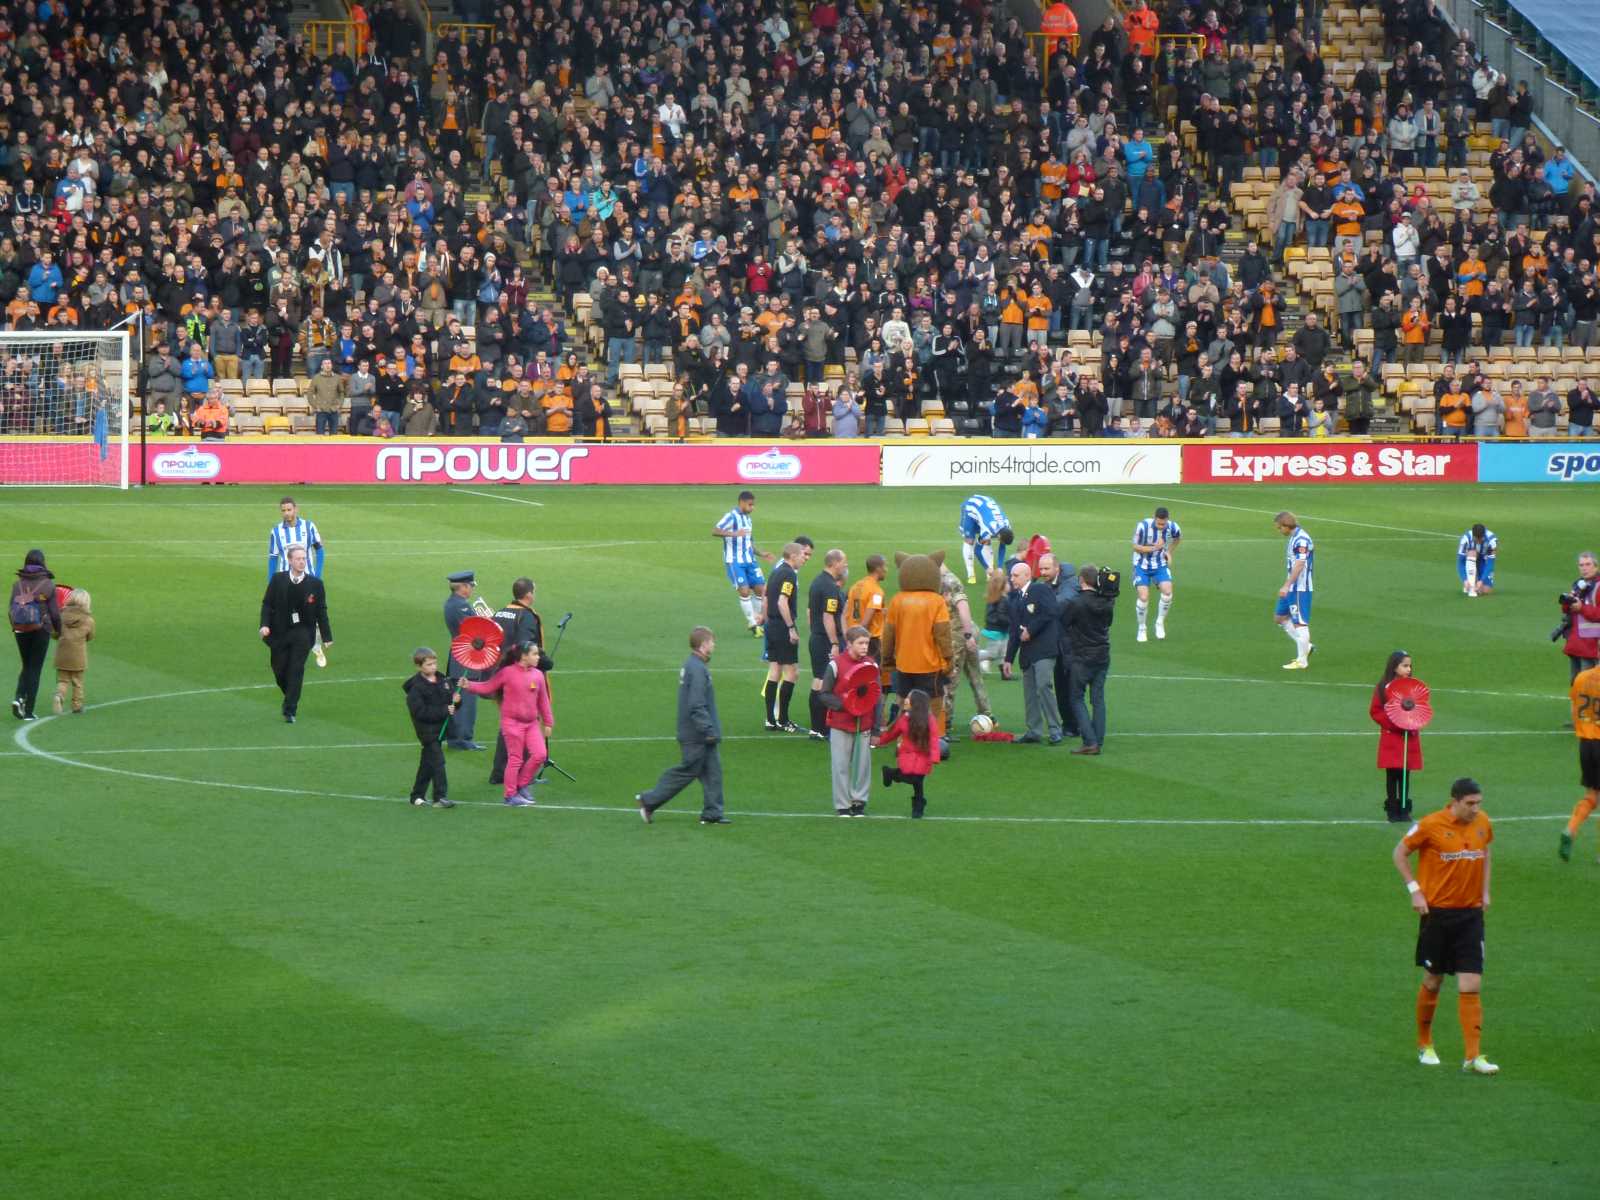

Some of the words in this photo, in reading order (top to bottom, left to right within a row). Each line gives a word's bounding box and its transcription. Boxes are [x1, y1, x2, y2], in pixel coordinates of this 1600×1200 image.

[376, 447, 589, 480] npower
[950, 452, 1101, 480] paints4trade.com
[1211, 449, 1347, 482] Express
[1351, 451, 1374, 476] &
[1378, 447, 1451, 476] Star
